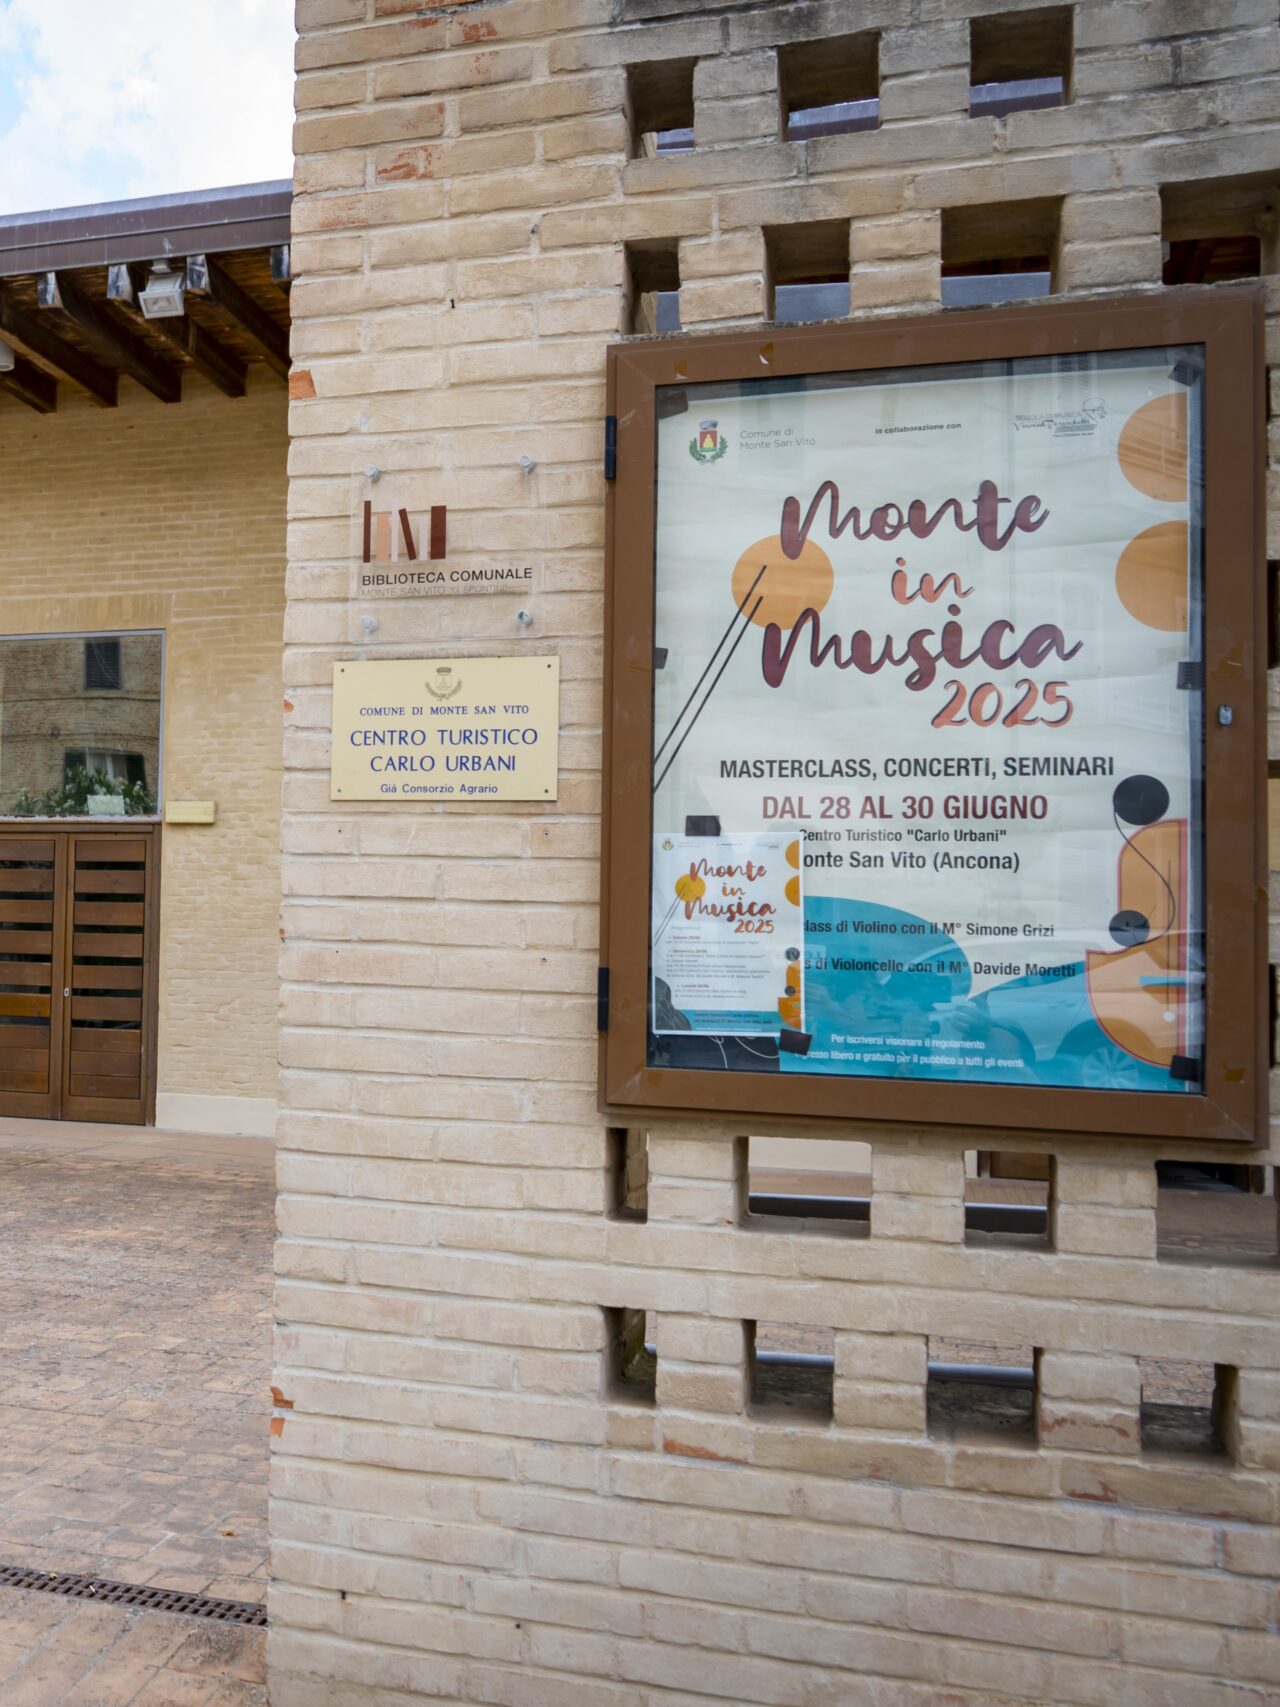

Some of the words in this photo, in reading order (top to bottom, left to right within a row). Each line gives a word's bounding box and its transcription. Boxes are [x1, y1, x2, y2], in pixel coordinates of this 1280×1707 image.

[740, 429, 782, 439] Comune
[784, 427, 794, 436] di
[884, 424, 944, 434] collaborazione
[740, 440, 771, 450] Monte
[774, 439, 793, 448] San
[795, 437, 816, 446] Vito
[780, 479, 1051, 560] Monte
[362, 572, 446, 586] BIBLIOTECA
[450, 568, 533, 582] COMUNALE
[891, 557, 975, 605] in
[761, 603, 1084, 691] Musica
[359, 707, 405, 716] COMUNE
[412, 706, 423, 715] DI
[430, 706, 468, 715] MONTE
[474, 705, 496, 714] SAN
[503, 705, 529, 714] VITO
[931, 678, 1074, 729] 2025
[350, 729, 426, 746] CENTRO
[437, 728, 538, 745] TURISTICO
[370, 755, 435, 772] CARLO
[446, 755, 516, 771] URBANI
[720, 758, 878, 781] MASTERCLASS,
[884, 757, 996, 780] CONCERTI,
[1003, 756, 1113, 777] SEMINARI
[402, 783, 454, 793] Consorzio
[459, 783, 498, 795] Agrario
[762, 795, 812, 819] DAL
[819, 795, 851, 819] 28
[859, 795, 893, 819] AL
[902, 795, 934, 819] 30
[943, 794, 1048, 819] GIUGNO
[846, 828, 902, 841] Turistico
[907, 829, 949, 842] "Carlo
[954, 829, 1007, 842] Urbani"
[689, 858, 767, 882] Monte
[803, 852, 843, 868] onte
[849, 852, 884, 868] San
[891, 851, 926, 869] Vito
[933, 851, 1020, 873] (Ancona)
[722, 882, 746, 897] in
[684, 896, 777, 922] Musica
[734, 918, 775, 934] 2025
[836, 920, 848, 933] di
[852, 921, 897, 934] Violino
[901, 924, 926, 934] con
[930, 922, 938, 934] il
[942, 922, 962, 935] M°
[966, 923, 1018, 936] Simone
[1023, 924, 1055, 937] Grizi
[815, 958, 827, 970] di
[831, 958, 904, 972] Violoncello
[908, 962, 933, 972] con
[937, 960, 945, 973] il
[949, 960, 969, 974] M°
[973, 962, 1020, 975] Davide
[1025, 963, 1076, 977] Moretti
[831, 1033, 845, 1044] Per
[846, 1035, 884, 1045] iscriversi
[885, 1036, 922, 1047] visionare
[924, 1037, 931, 1048] il
[932, 1038, 985, 1049] regolamento
[831, 1050, 854, 1060] libero
[863, 1052, 896, 1063] gratuito
[912, 1053, 918, 1063] il
[920, 1054, 956, 1065] pubblico
[957, 1057, 963, 1065] a
[965, 1056, 982, 1066] tutti
[984, 1057, 995, 1068] gli
[997, 1058, 1024, 1068] eventi
